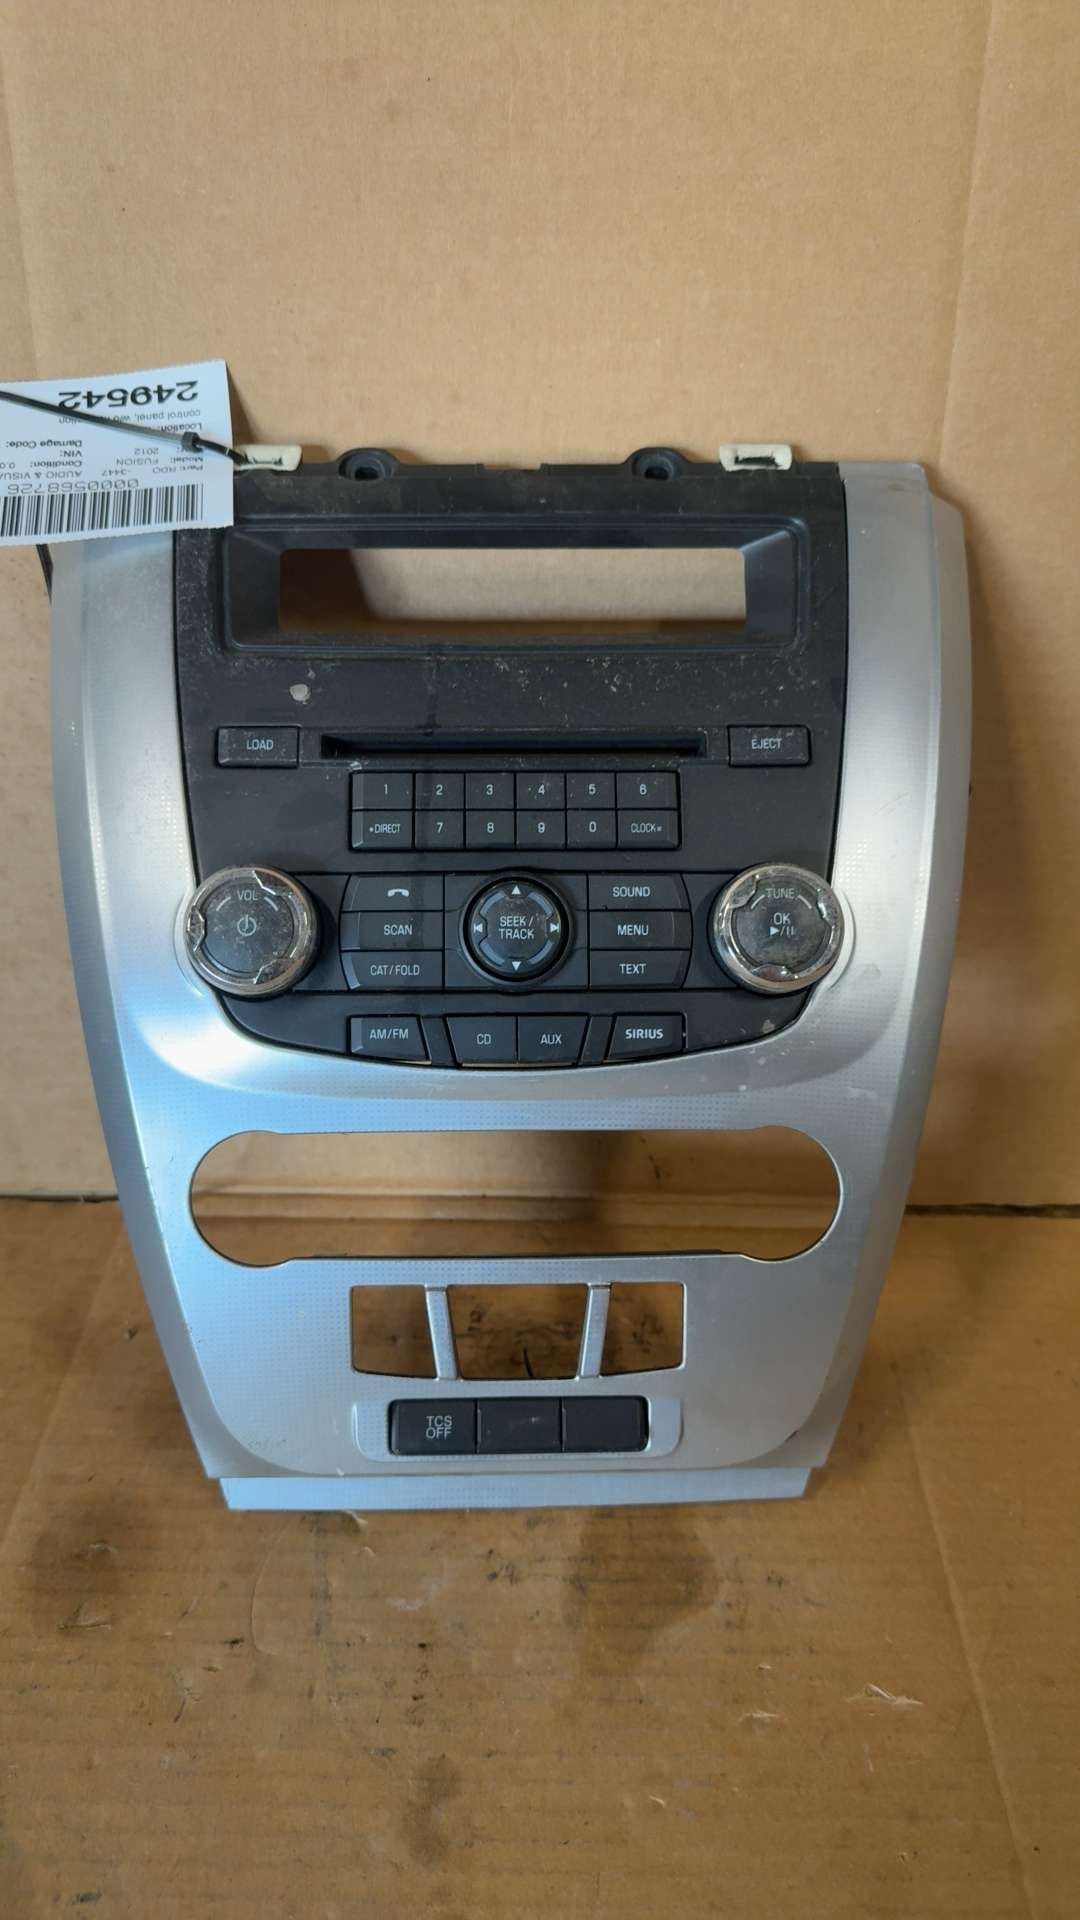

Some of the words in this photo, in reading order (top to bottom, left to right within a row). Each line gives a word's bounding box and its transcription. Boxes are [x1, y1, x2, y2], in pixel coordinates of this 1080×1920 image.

[58, 380, 198, 410] 249542
[134, 411, 164, 422] panel,
[168, 410, 200, 420] control
[6, 441, 37, 449] Code:
[39, 439, 82, 448] Damage
[134, 447, 159, 456] 2012
[30, 460, 82, 468] Condition:
[116, 458, 159, 466] FUSION
[170, 456, 203, 464] Model:
[46, 471, 82, 479] AUDIO
[7, 479, 139, 495] 0000568726
[246, 739, 274, 751] LOAD
[751, 738, 782, 750] EJECT
[383, 784, 389, 795] 1
[436, 784, 443, 795] 2
[486, 784, 494, 795] 3
[538, 784, 546, 795] 4
[588, 784, 596, 795] 5
[639, 784, 647, 795] 6
[436, 822, 444, 833] 7
[487, 822, 494, 833] 8
[538, 822, 545, 833] 9
[589, 822, 597, 833] 0
[237, 890, 258, 902] VOL
[612, 886, 650, 897] SOUND
[765, 888, 795, 899] TUNE
[773, 912, 791, 925] OK
[383, 924, 413, 936] SCAN
[499, 928, 535, 939] TRACK
[617, 924, 649, 936] MENU
[370, 964, 420, 977] CAT/FOLD
[619, 963, 646, 975] TEXT
[369, 1028, 409, 1040] AM/FM
[477, 1034, 492, 1045] CD
[540, 1033, 562, 1045] AUX
[625, 1028, 664, 1040] SIRIUS
[426, 1415, 453, 1427] TCS
[425, 1427, 452, 1439] OFF
